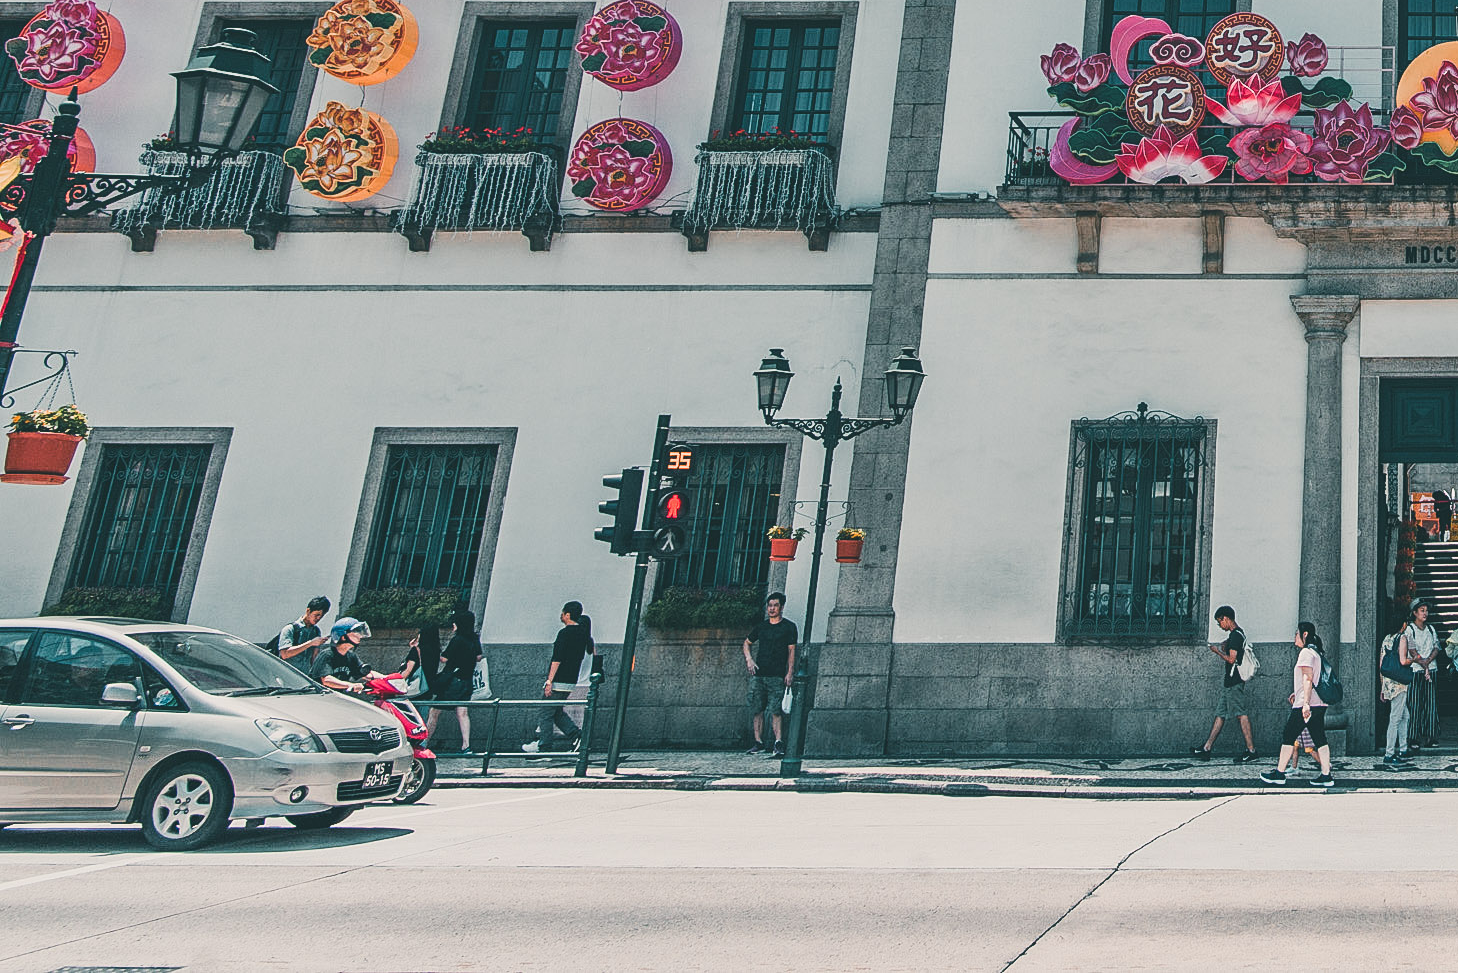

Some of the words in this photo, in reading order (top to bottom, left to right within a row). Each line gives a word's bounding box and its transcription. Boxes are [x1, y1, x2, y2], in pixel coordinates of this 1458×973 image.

[1136, 79, 1193, 122] 花
[1214, 28, 1274, 69] 好
[667, 451, 692, 470] 35
[374, 762, 386, 775] MS
[365, 773, 390, 787] 50-15
